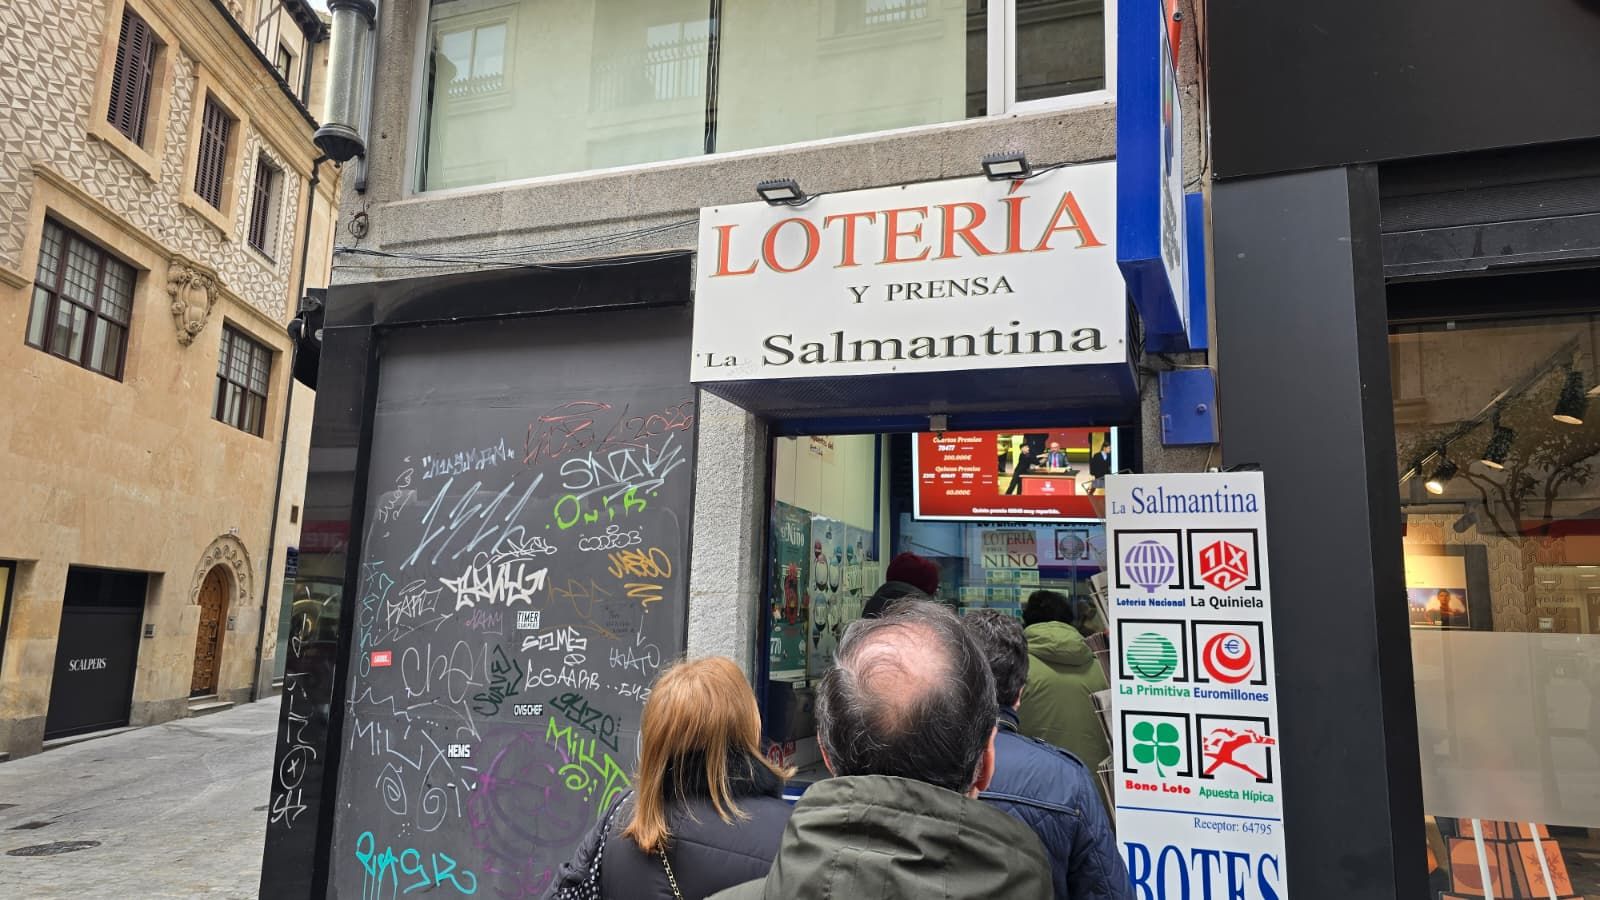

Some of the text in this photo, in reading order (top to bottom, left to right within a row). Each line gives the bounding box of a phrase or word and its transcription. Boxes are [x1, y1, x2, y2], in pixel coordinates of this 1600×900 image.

[709, 179, 1107, 278] LOTERÍA
[849, 275, 1015, 304] Y PRENSA
[703, 320, 1107, 368] La Salmantina
[1112, 485, 1259, 515] La Salmantina
[1148, 598, 1186, 607] Nacional
[1191, 596, 1264, 609] La Quiniela
[69, 657, 107, 671] SCALPERS
[1119, 685, 1190, 697] La Primitiva
[1194, 688, 1269, 701] Euromillones
[447, 744, 471, 758] HEMS
[1125, 780, 1191, 794] Bono Loto
[1199, 787, 1274, 803] Apuesta Hípica
[1194, 817, 1272, 835] Receptor: 64795
[1123, 841, 1280, 900] BOTES
